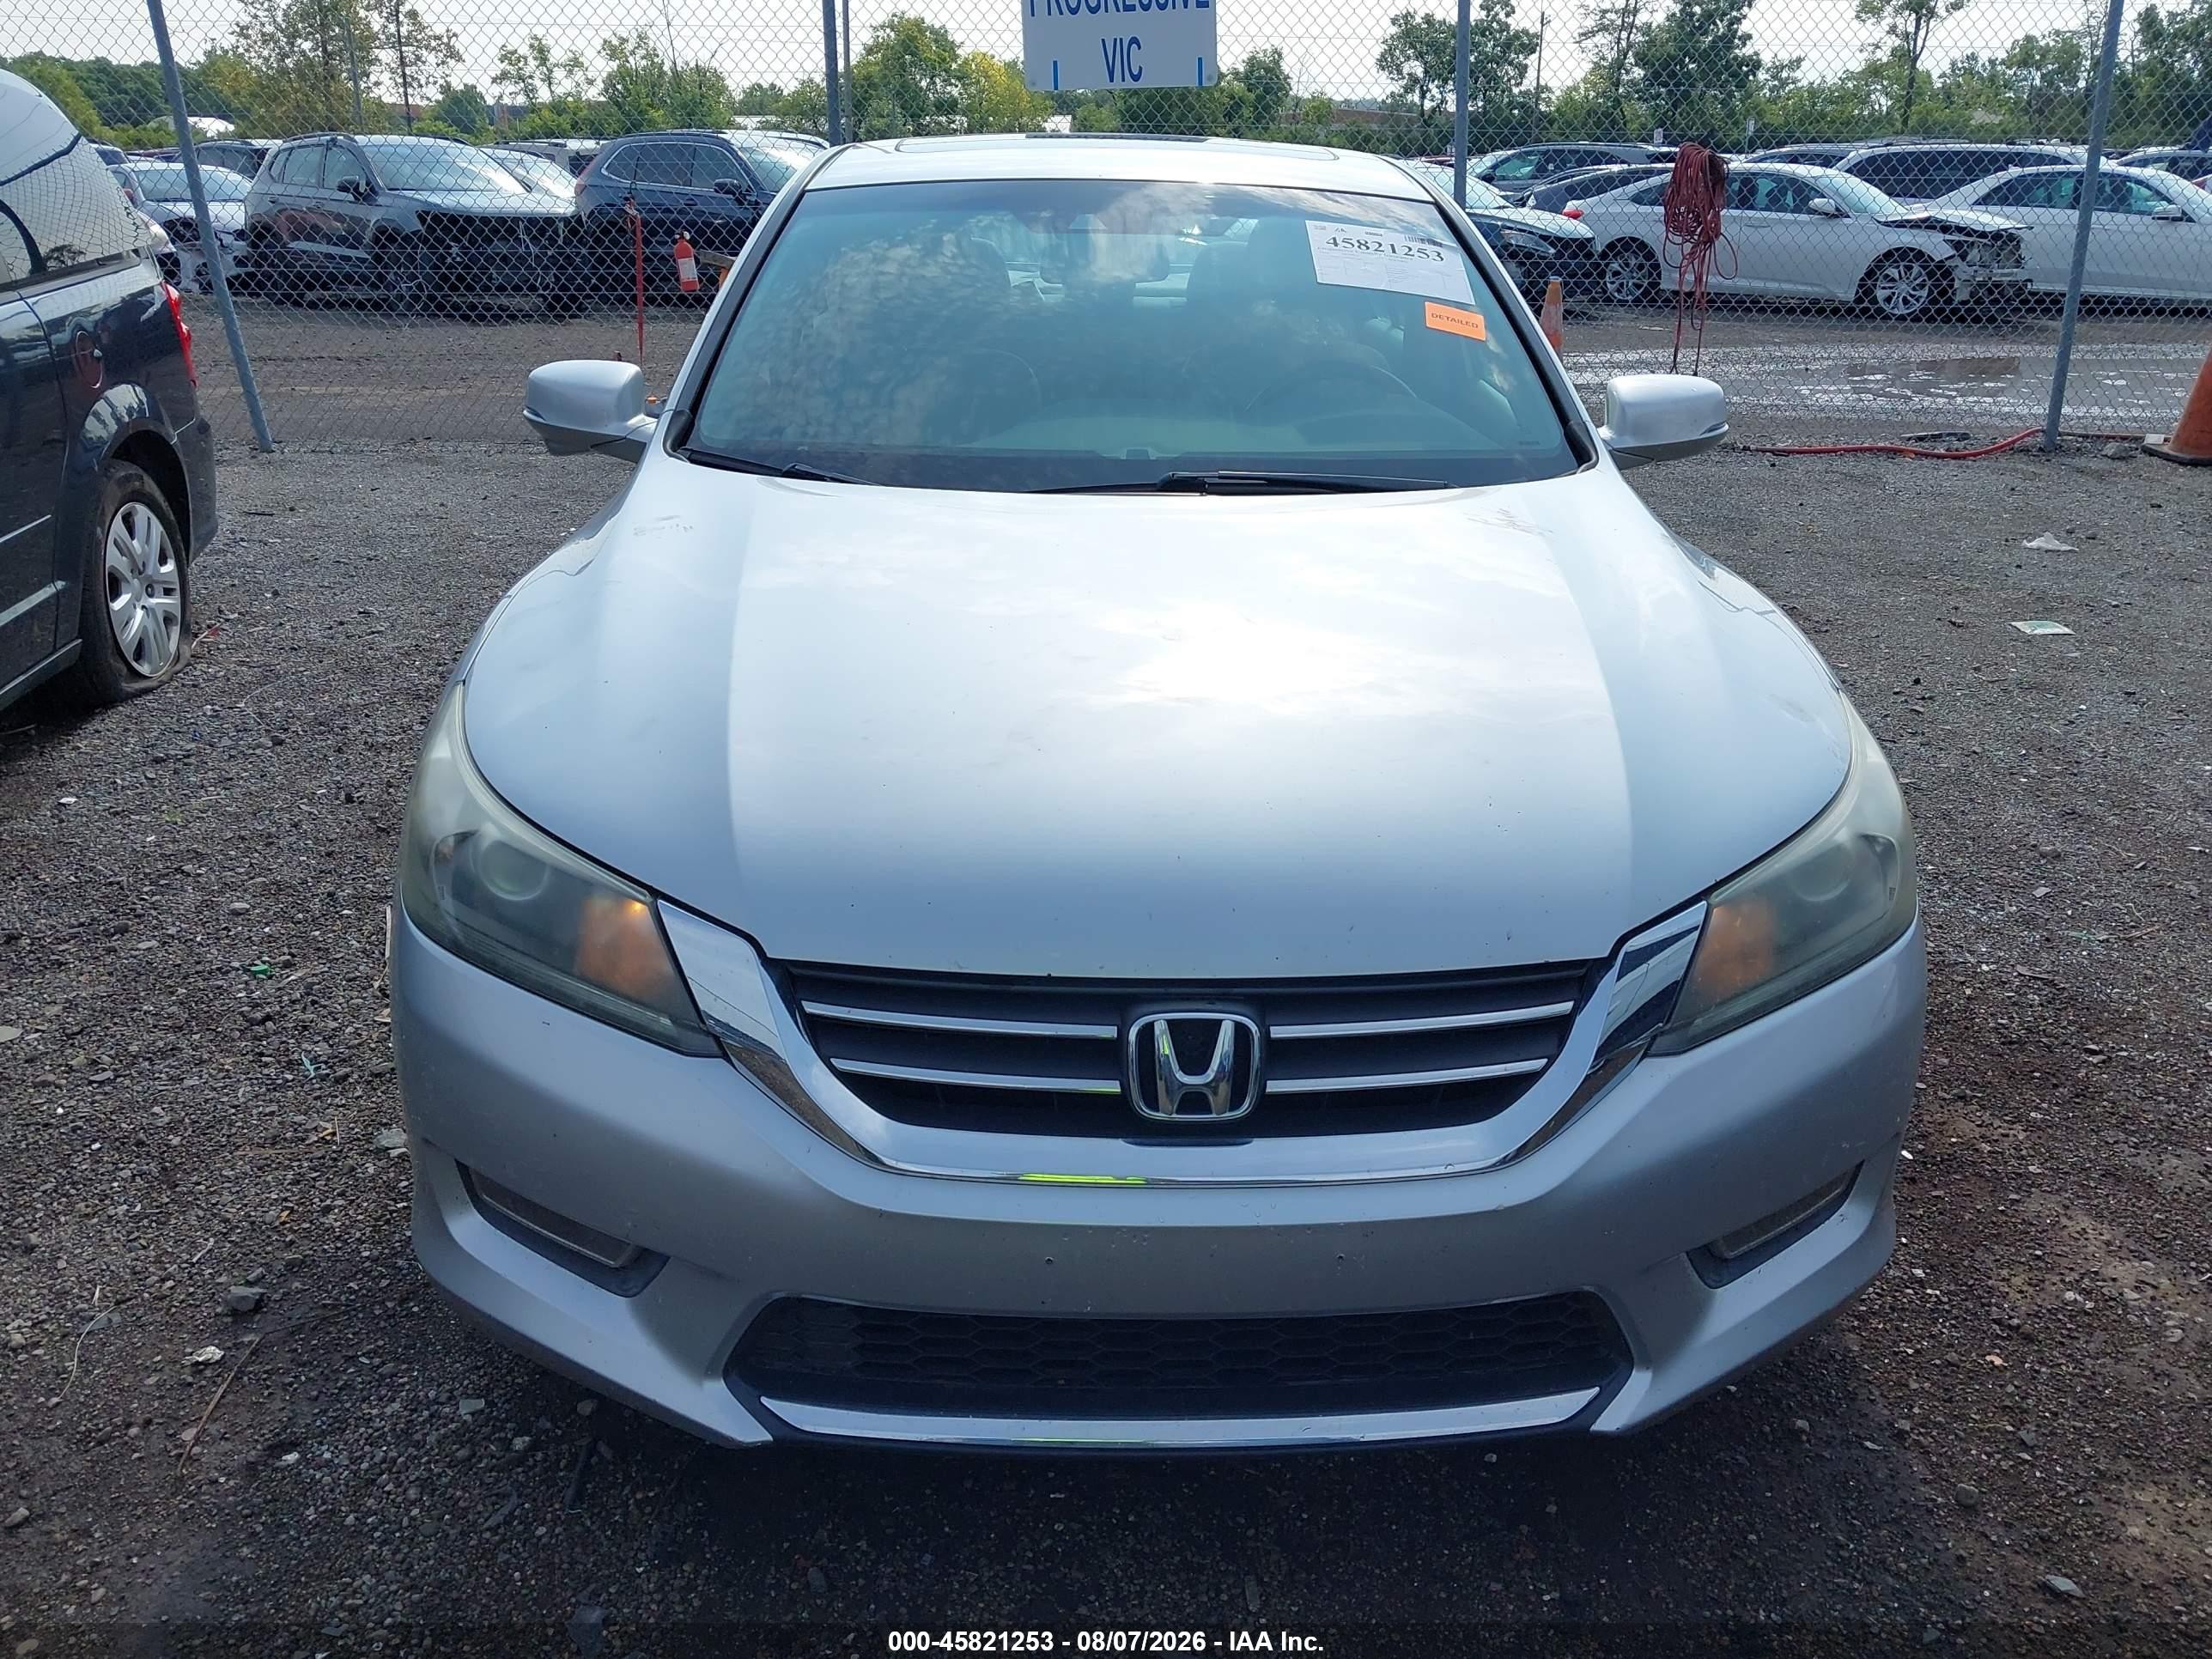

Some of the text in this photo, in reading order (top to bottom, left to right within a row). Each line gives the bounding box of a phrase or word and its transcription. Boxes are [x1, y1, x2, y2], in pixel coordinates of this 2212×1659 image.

[1101, 36, 1143, 82] VIC
[1325, 236, 1444, 262] 45821253
[1431, 313, 1479, 329] DETAILED
